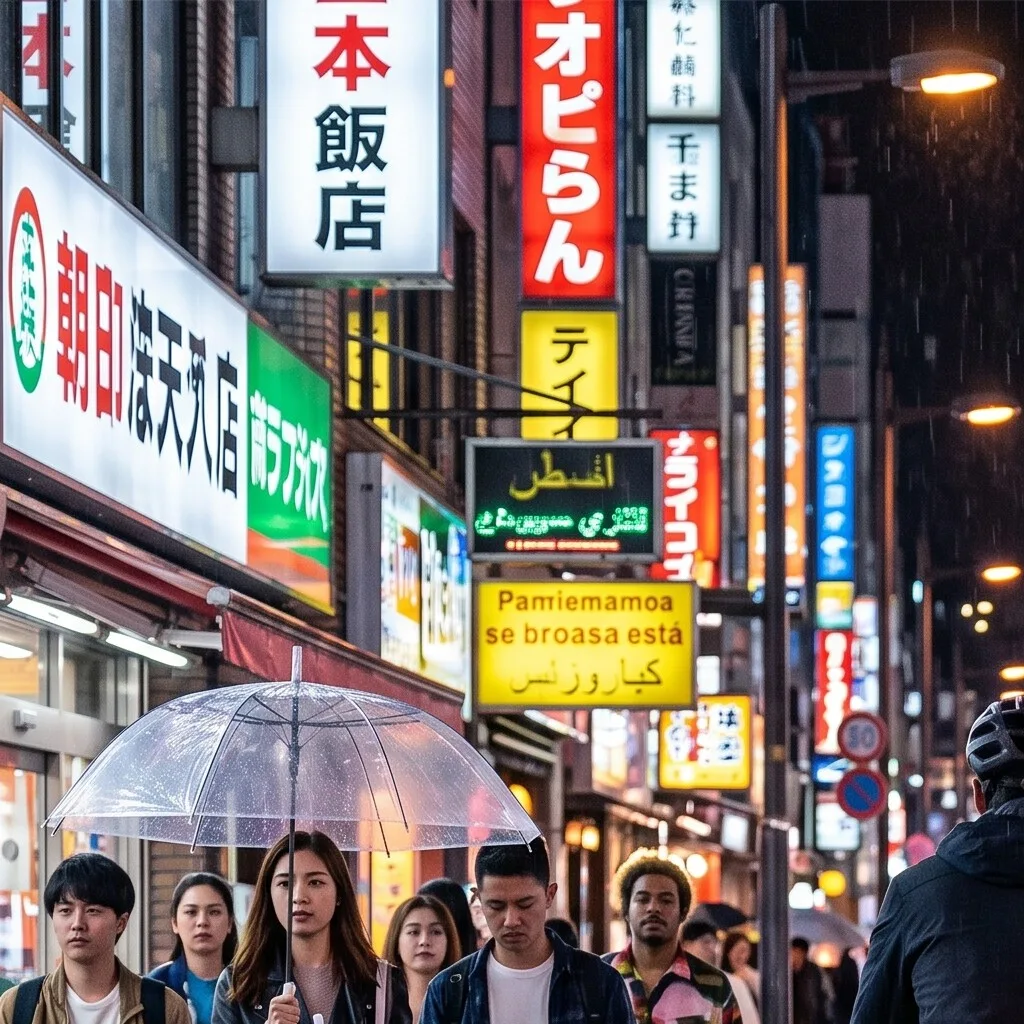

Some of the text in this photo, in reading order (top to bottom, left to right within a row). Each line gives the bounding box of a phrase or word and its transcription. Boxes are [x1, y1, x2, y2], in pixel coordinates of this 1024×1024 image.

[313, 0, 391, 250] 本飯店
[533, 0, 604, 285] オピらん
[485, 626, 515, 645] se
[524, 622, 619, 645] broasa
